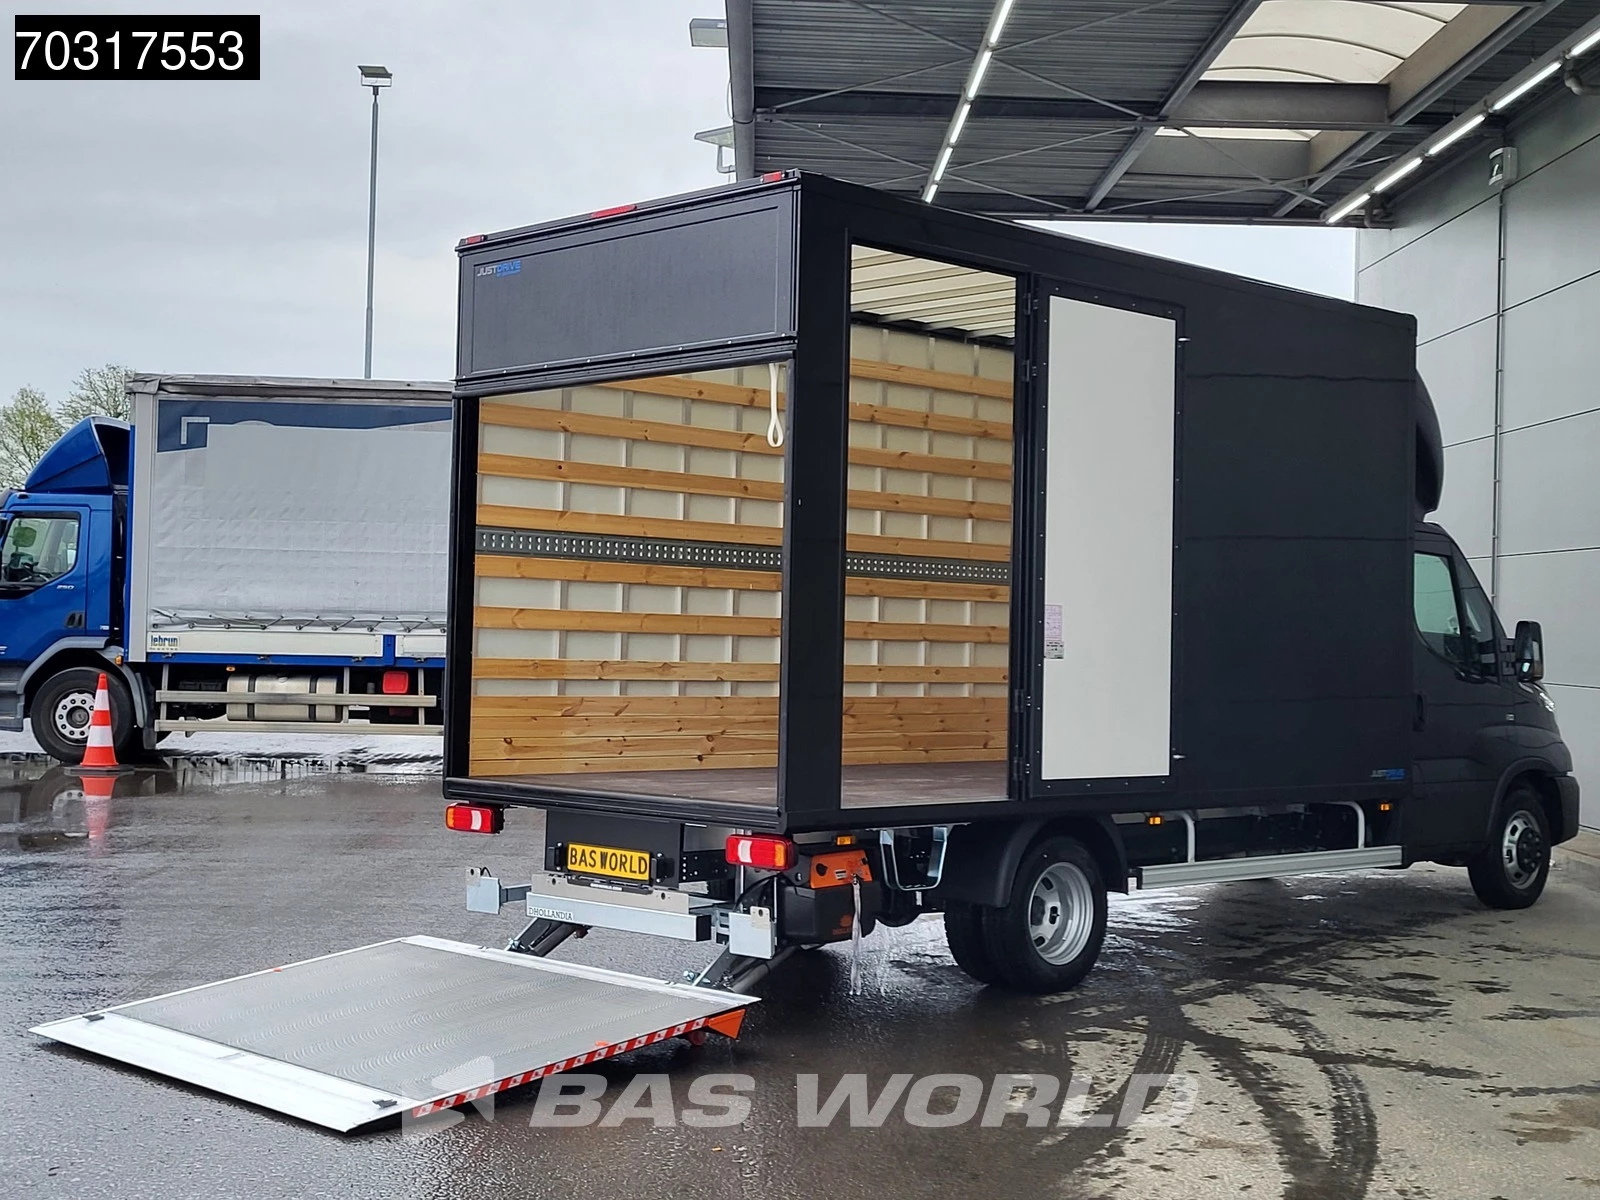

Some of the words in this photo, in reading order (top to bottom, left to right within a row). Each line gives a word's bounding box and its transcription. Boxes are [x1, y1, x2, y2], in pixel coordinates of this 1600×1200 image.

[476, 260, 521, 277] JUSTDRIVE
[150, 634, 178, 647] lebrun
[569, 847, 597, 868] BAS
[600, 851, 648, 875] WORLD
[528, 907, 573, 921] DHOLLANDIA
